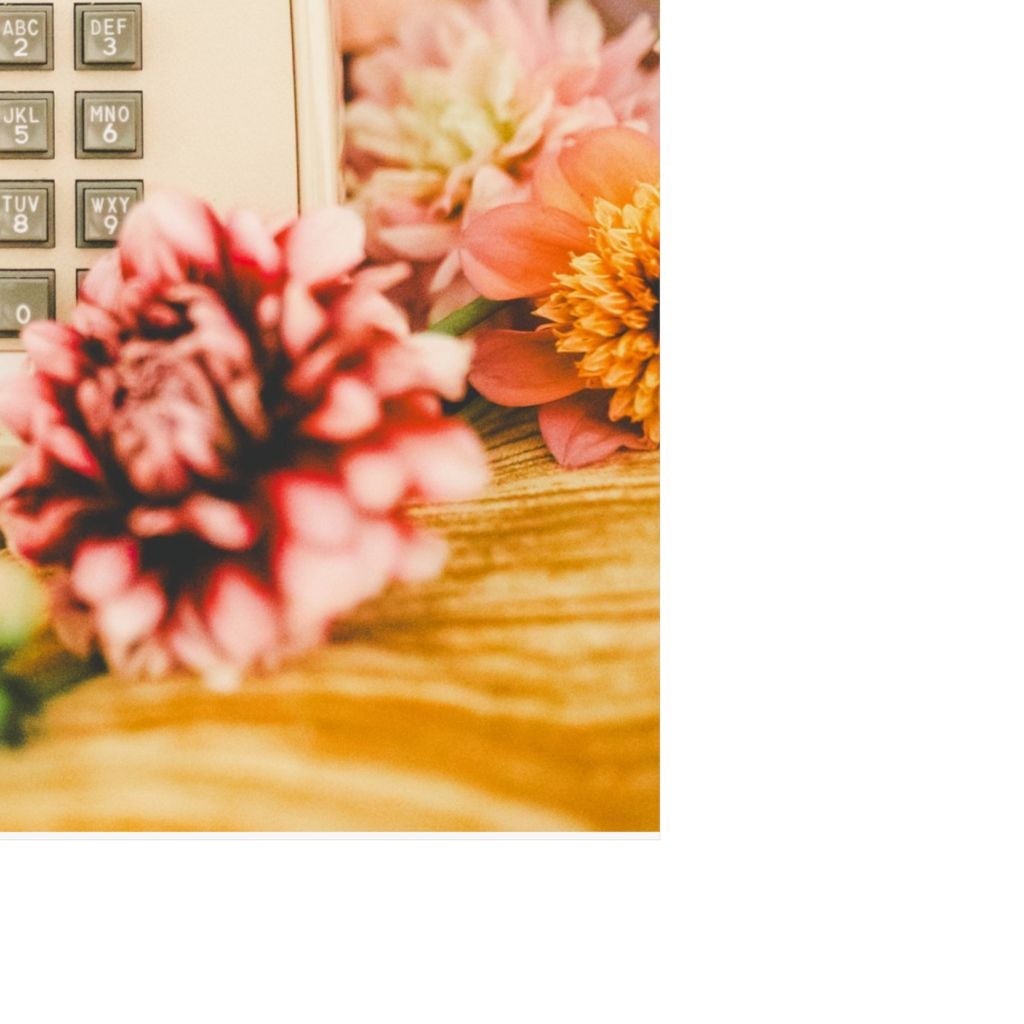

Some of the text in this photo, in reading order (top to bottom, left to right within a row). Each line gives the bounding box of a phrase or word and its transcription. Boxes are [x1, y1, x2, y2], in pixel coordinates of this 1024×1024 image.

[2, 20, 39, 35] ABC
[91, 19, 127, 35] DEF
[13, 38, 28, 57] 2
[103, 38, 117, 56] 3
[4, 107, 39, 123] JKL
[90, 105, 130, 121] MNO
[15, 125, 28, 144] 5
[103, 124, 117, 143] 6
[2, 196, 39, 212] TUV
[92, 197, 130, 213] WXY
[13, 214, 28, 233] 8
[104, 216, 118, 235] 9
